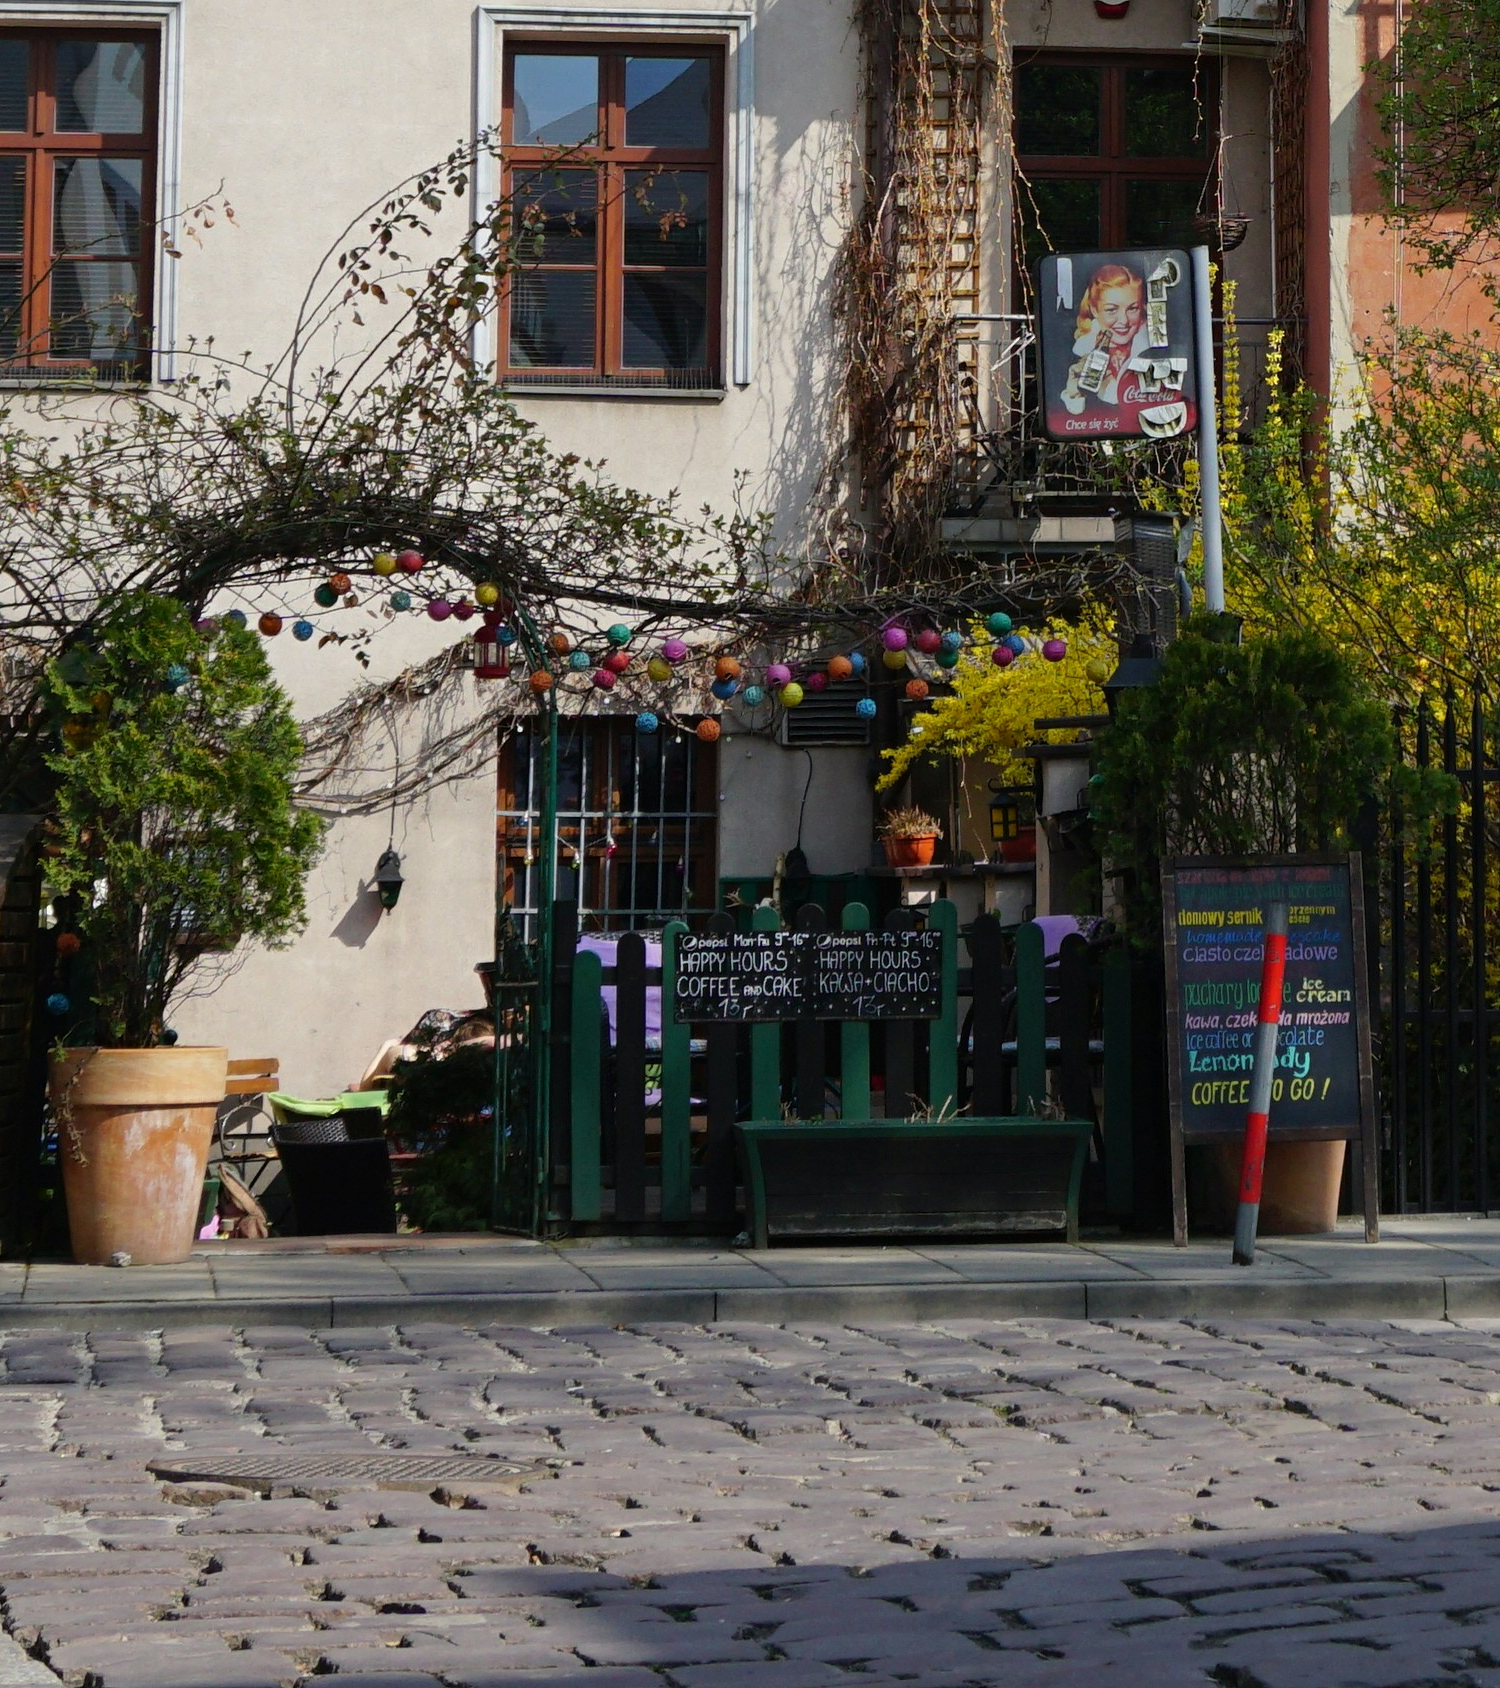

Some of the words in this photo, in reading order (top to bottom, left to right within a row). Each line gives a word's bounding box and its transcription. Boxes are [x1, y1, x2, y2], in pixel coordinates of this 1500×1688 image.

[1065, 419, 1088, 431] Chce
[1089, 417, 1101, 431] się
[1102, 417, 1119, 431] żyć
[1178, 909, 1225, 927] domowy
[1226, 907, 1263, 925] sernik
[1187, 928, 1263, 944] homemade
[680, 952, 726, 972] HAPPY
[730, 950, 788, 972] HOURS
[820, 950, 864, 969] HAPPY
[869, 950, 921, 969] HOURS
[1182, 944, 1231, 962] ciasto
[677, 975, 740, 997] COFFEE
[743, 984, 762, 997] AND
[762, 975, 803, 997] CAKE
[873, 972, 930, 993] CIACHO
[1302, 976, 1325, 990] ice
[1183, 979, 1244, 1011] puchary
[1295, 990, 1351, 1003] cream
[1225, 1010, 1292, 1028] czekda
[1296, 1010, 1350, 1026] mrożona
[1205, 1029, 1239, 1049] coffee
[1242, 1032, 1254, 1048] or
[1276, 1025, 1325, 1046] colate
[1189, 1045, 1311, 1078] Lemondy
[1191, 1079, 1250, 1105] COFFEE
[1290, 1078, 1315, 1101] GO
